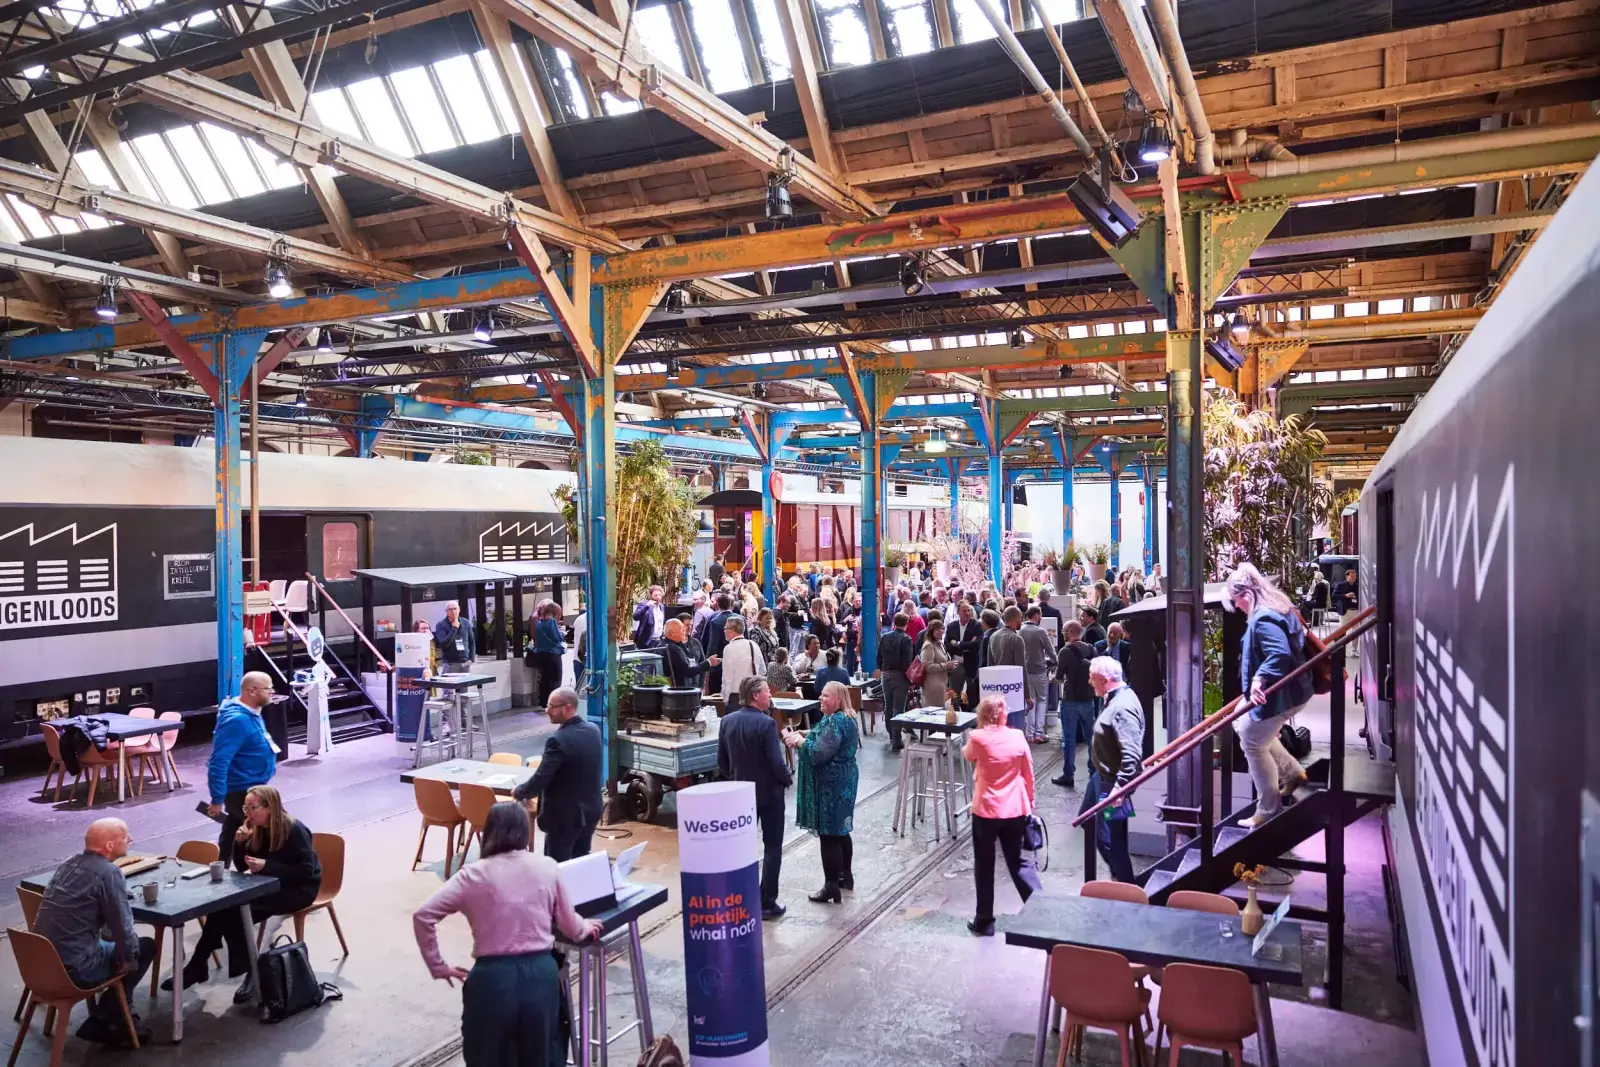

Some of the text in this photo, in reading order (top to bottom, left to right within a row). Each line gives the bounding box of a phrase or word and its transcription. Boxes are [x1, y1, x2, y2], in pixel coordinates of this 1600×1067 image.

[684, 815, 752, 833] WeSeeDo
[706, 893, 721, 909] in
[724, 893, 743, 907] de
[689, 918, 756, 940] whai not?
